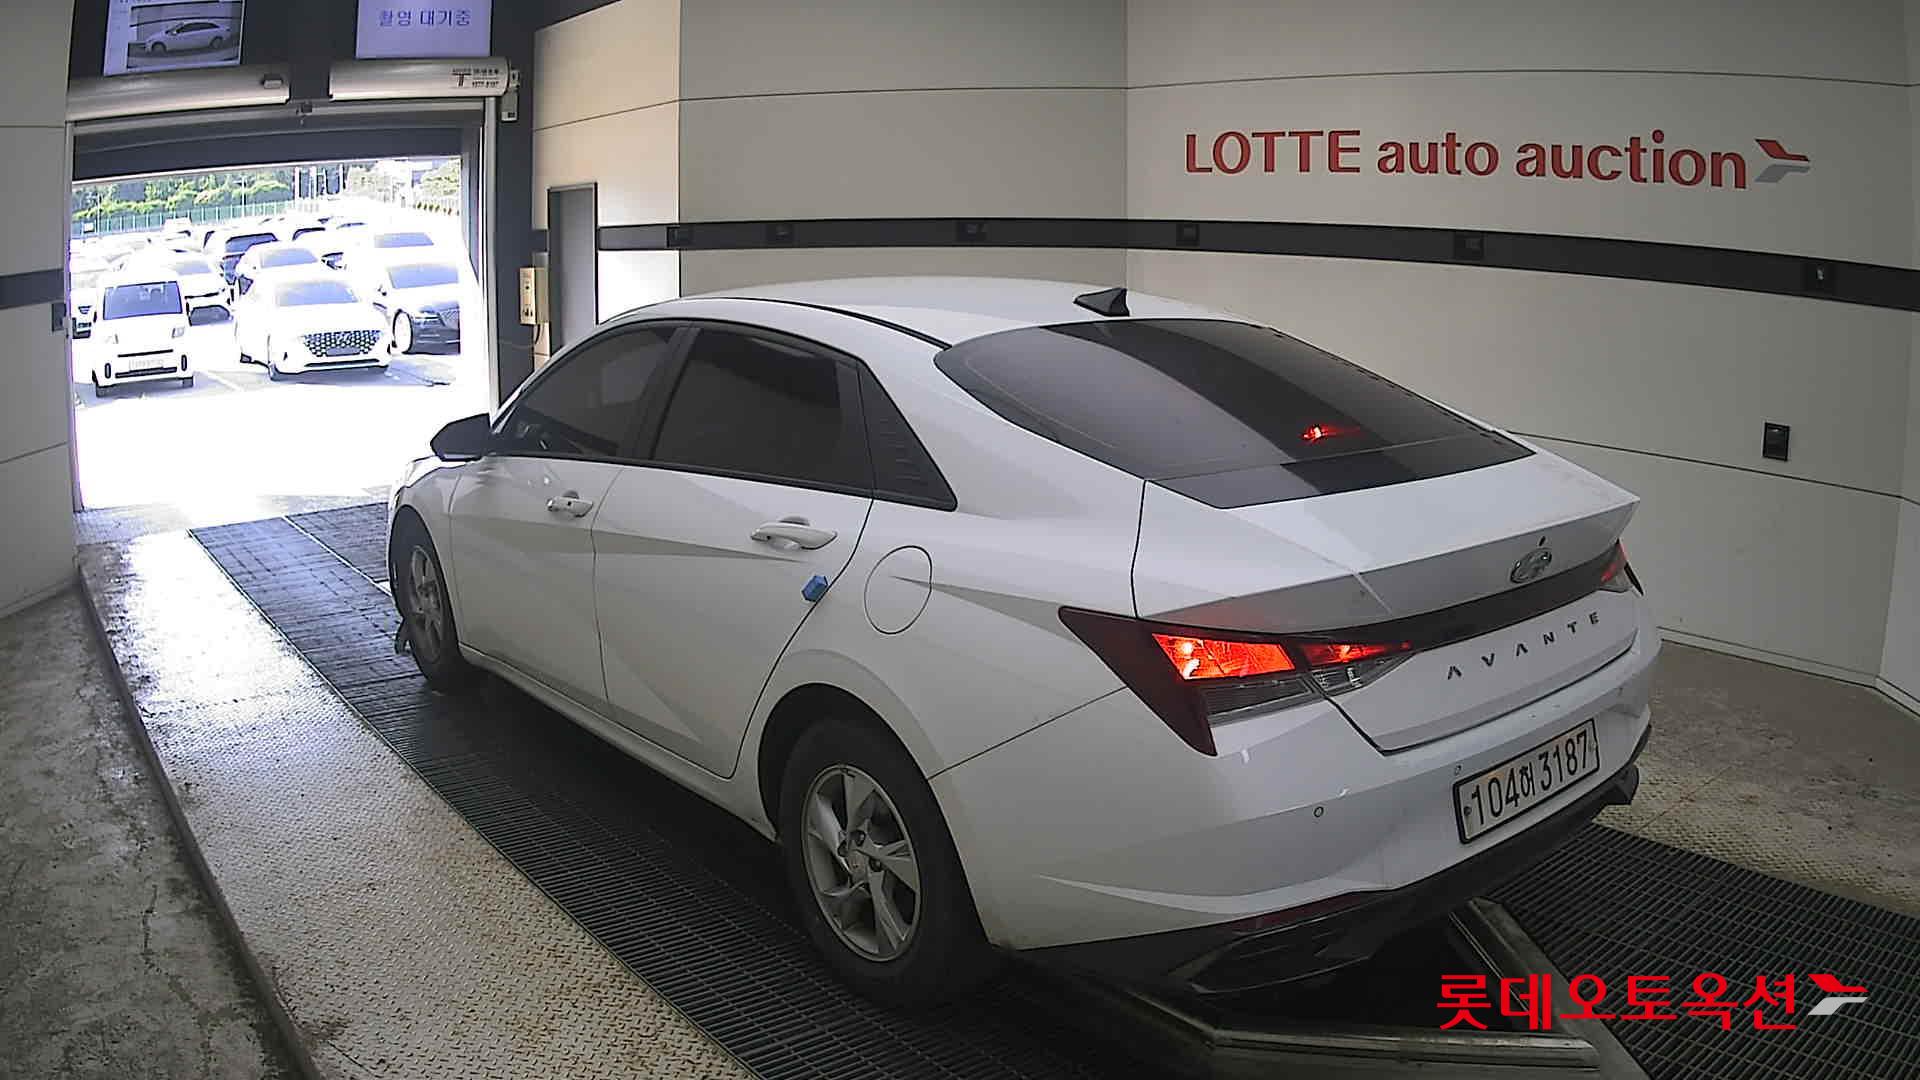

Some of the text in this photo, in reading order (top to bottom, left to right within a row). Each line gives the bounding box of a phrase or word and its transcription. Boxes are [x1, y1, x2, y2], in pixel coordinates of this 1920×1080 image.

[379, 9, 472, 27] 촬영 대기중
[1186, 129, 1748, 188] LOTTE auto auction
[1447, 612, 1600, 680] AVANTE
